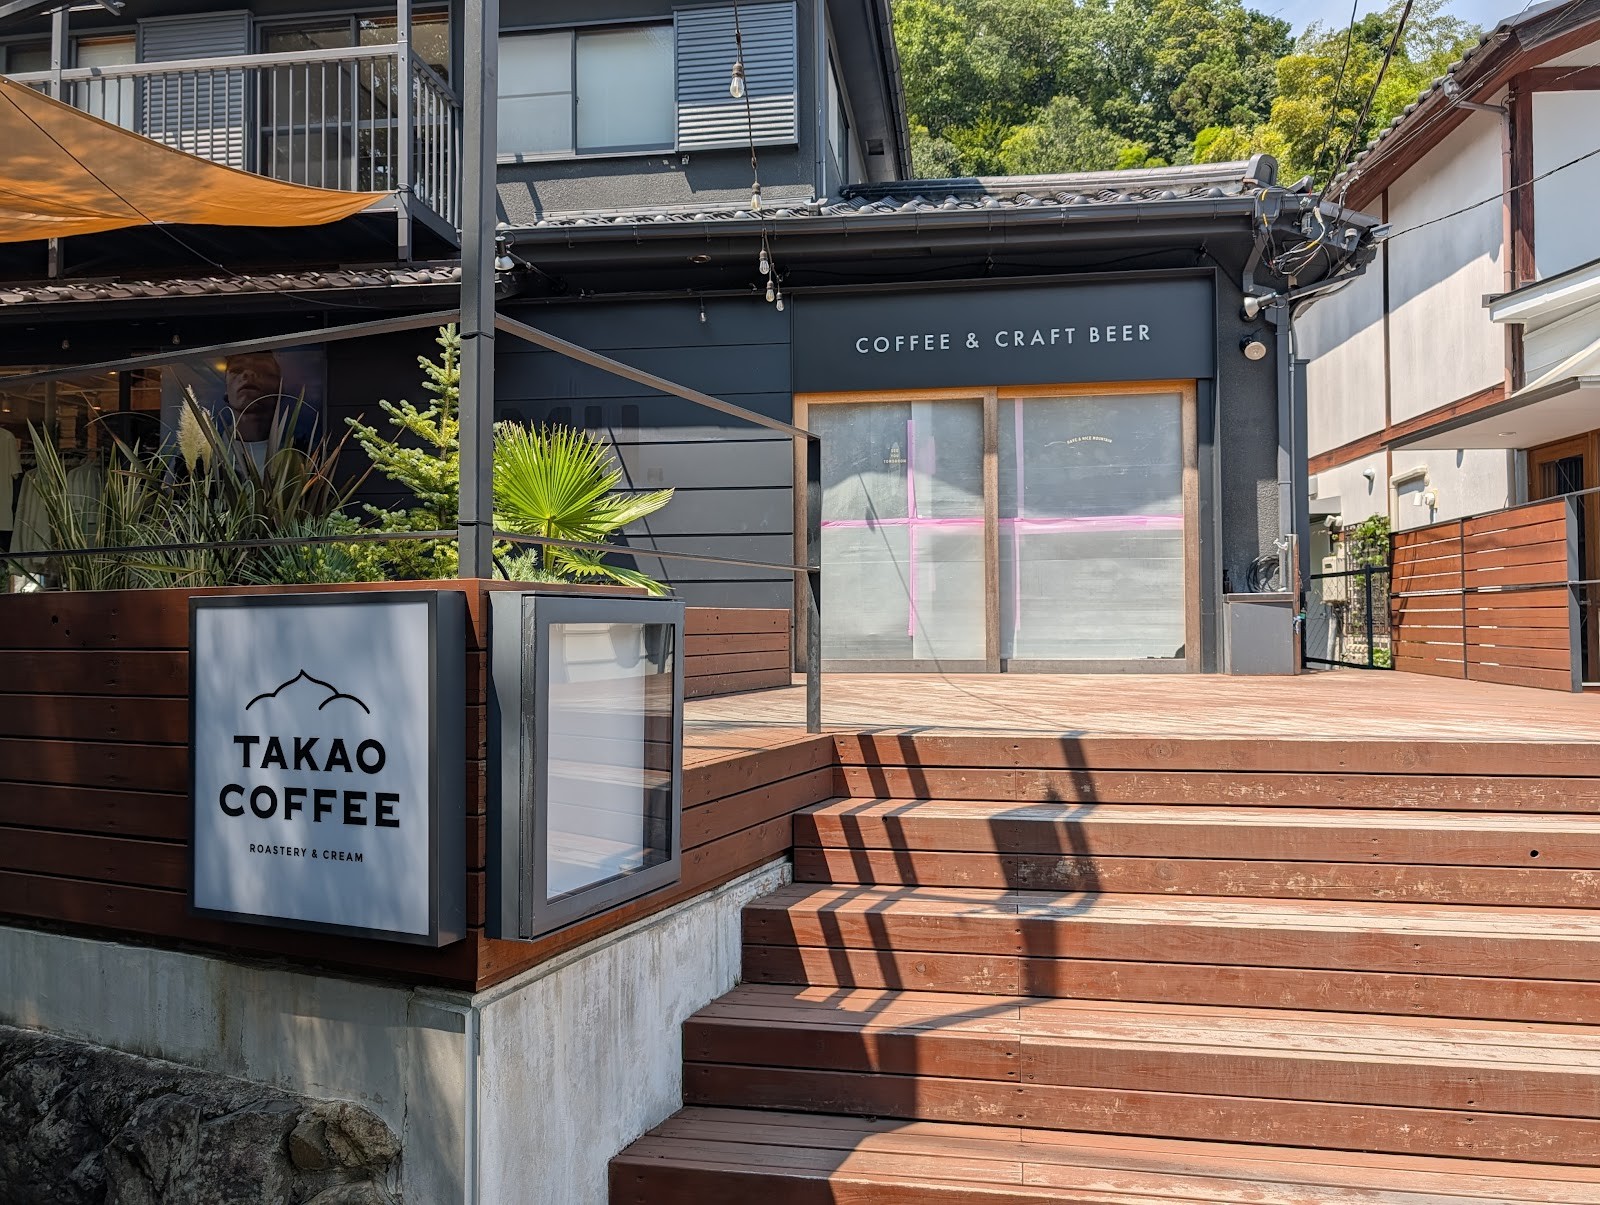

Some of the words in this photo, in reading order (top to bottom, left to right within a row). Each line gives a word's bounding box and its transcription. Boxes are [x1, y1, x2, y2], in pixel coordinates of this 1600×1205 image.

[855, 333, 950, 354] COFFEE
[965, 332, 980, 349] &
[995, 327, 1076, 348] CRAFT
[1089, 324, 1151, 344] BEER
[233, 735, 386, 774] TAKAO
[219, 783, 400, 828] COFFEE
[249, 843, 307, 858] ROASTERY
[311, 849, 318, 859] &
[322, 850, 363, 863] CREAM
